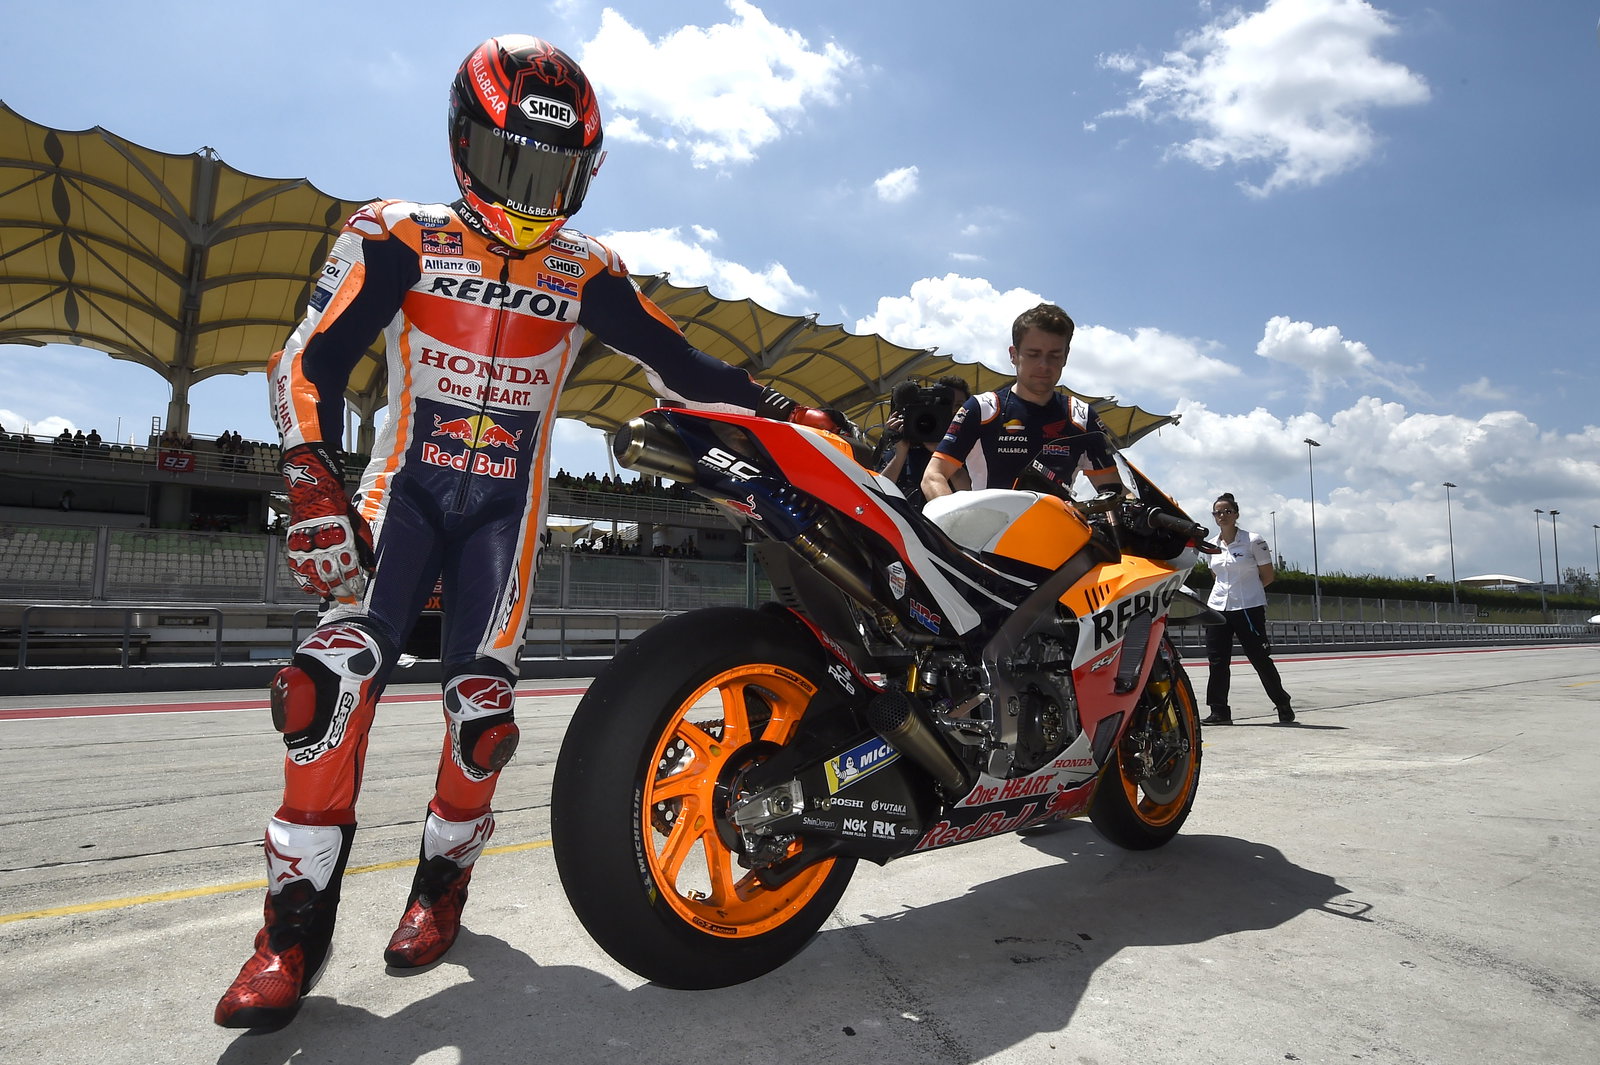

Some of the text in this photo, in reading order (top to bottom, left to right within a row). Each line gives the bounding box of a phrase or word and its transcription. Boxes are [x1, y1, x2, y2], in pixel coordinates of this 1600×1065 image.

[471, 52, 506, 114] PULL&BEAR
[529, 99, 571, 124] SHOEI
[492, 127, 528, 146] GIVES
[534, 135, 559, 154] YOU
[506, 198, 558, 216] PULL&BEAR
[422, 243, 463, 255] Red Bull
[551, 238, 587, 253] REPSOL
[424, 258, 464, 271] Allianz
[549, 259, 580, 276] SHOEI
[537, 272, 578, 297] HRC
[428, 277, 573, 322] REPSOL
[418, 347, 550, 385] HONDA
[276, 375, 288, 399] Satu
[437, 377, 532, 406] One HEART.
[163, 456, 190, 468] 93
[421, 441, 518, 479] Red Bull
[1042, 444, 1070, 456] HRC
[702, 447, 761, 480] SC
[909, 597, 941, 635] HRC
[1052, 758, 1093, 770] HONDA
[965, 774, 1055, 806] One HEART.
[830, 797, 864, 808] GOSHI
[879, 802, 907, 813] YUTAKA
[633, 788, 647, 873] MICHELIN
[843, 818, 868, 832] NGK
[873, 820, 896, 836] RK
[916, 802, 1037, 850] Red Bull
